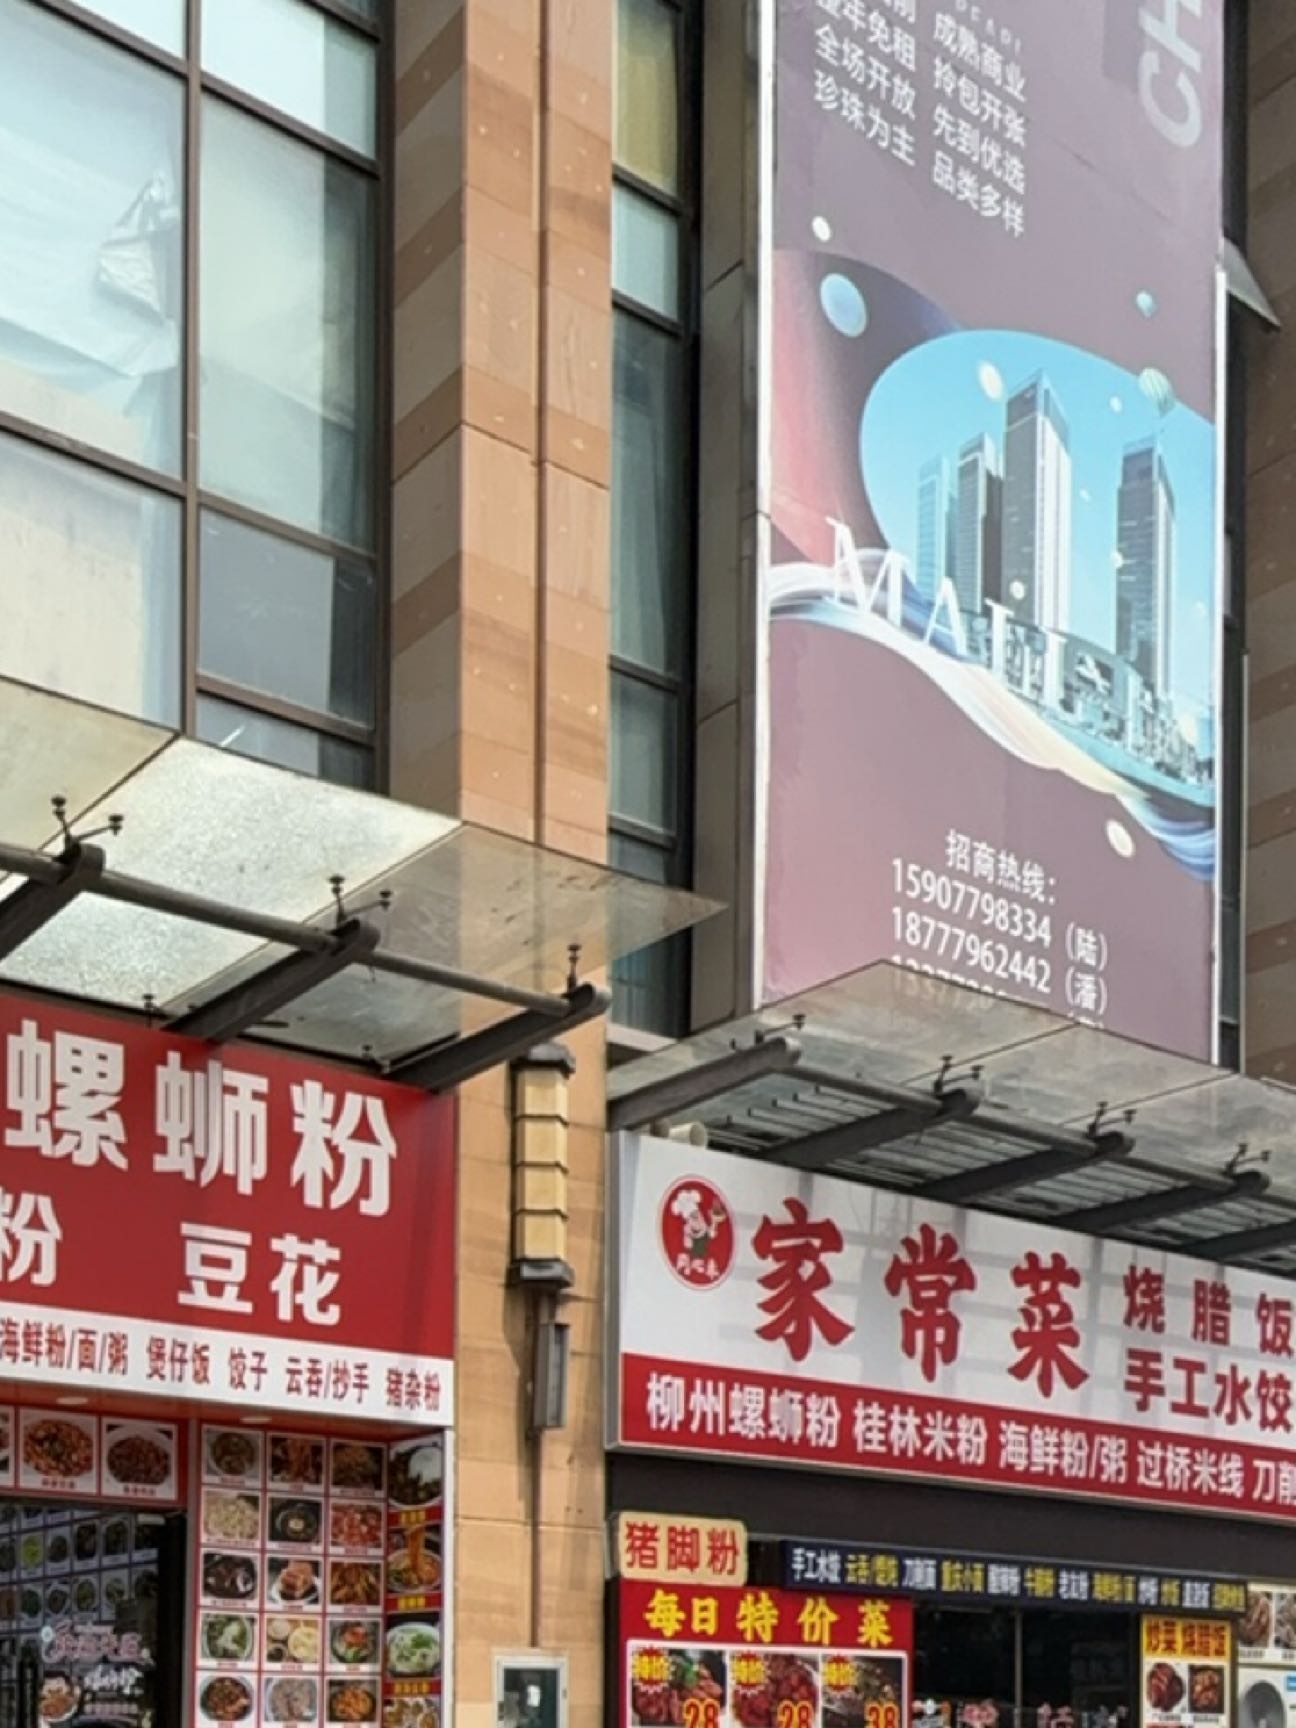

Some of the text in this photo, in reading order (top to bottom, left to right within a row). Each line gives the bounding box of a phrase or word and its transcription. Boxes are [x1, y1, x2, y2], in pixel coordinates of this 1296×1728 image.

[814, 24, 917, 121] 全场开放
[933, 12, 1027, 102] 成熟商业
[933, 56, 1027, 148] 拎包开张
[933, 104, 1026, 196] 先到优选
[933, 151, 1025, 238] 品类多样
[891, 857, 1052, 949] 15907798334
[891, 906, 1052, 993] 18777962442
[177, 1221, 341, 1327] 豆花
[750, 1196, 1089, 1399] 家常菜
[1123, 1264, 1295, 1360] 烧腊饭
[145, 1336, 211, 1385] 煲仔饭
[227, 1346, 268, 1392] 饺子
[285, 1355, 370, 1404] 云吞/抄手
[1124, 1347, 1295, 1435] 手工水饺
[646, 1371, 842, 1450] 柳州螺蛳粉
[853, 1398, 989, 1468] 桂林米粉
[998, 1420, 1129, 1485] 海鲜粉/粥
[1137, 1439, 1246, 1499] 过桥米线
[625, 1520, 742, 1577] 猪脚粉
[644, 1588, 895, 1649] 每日特价菜
